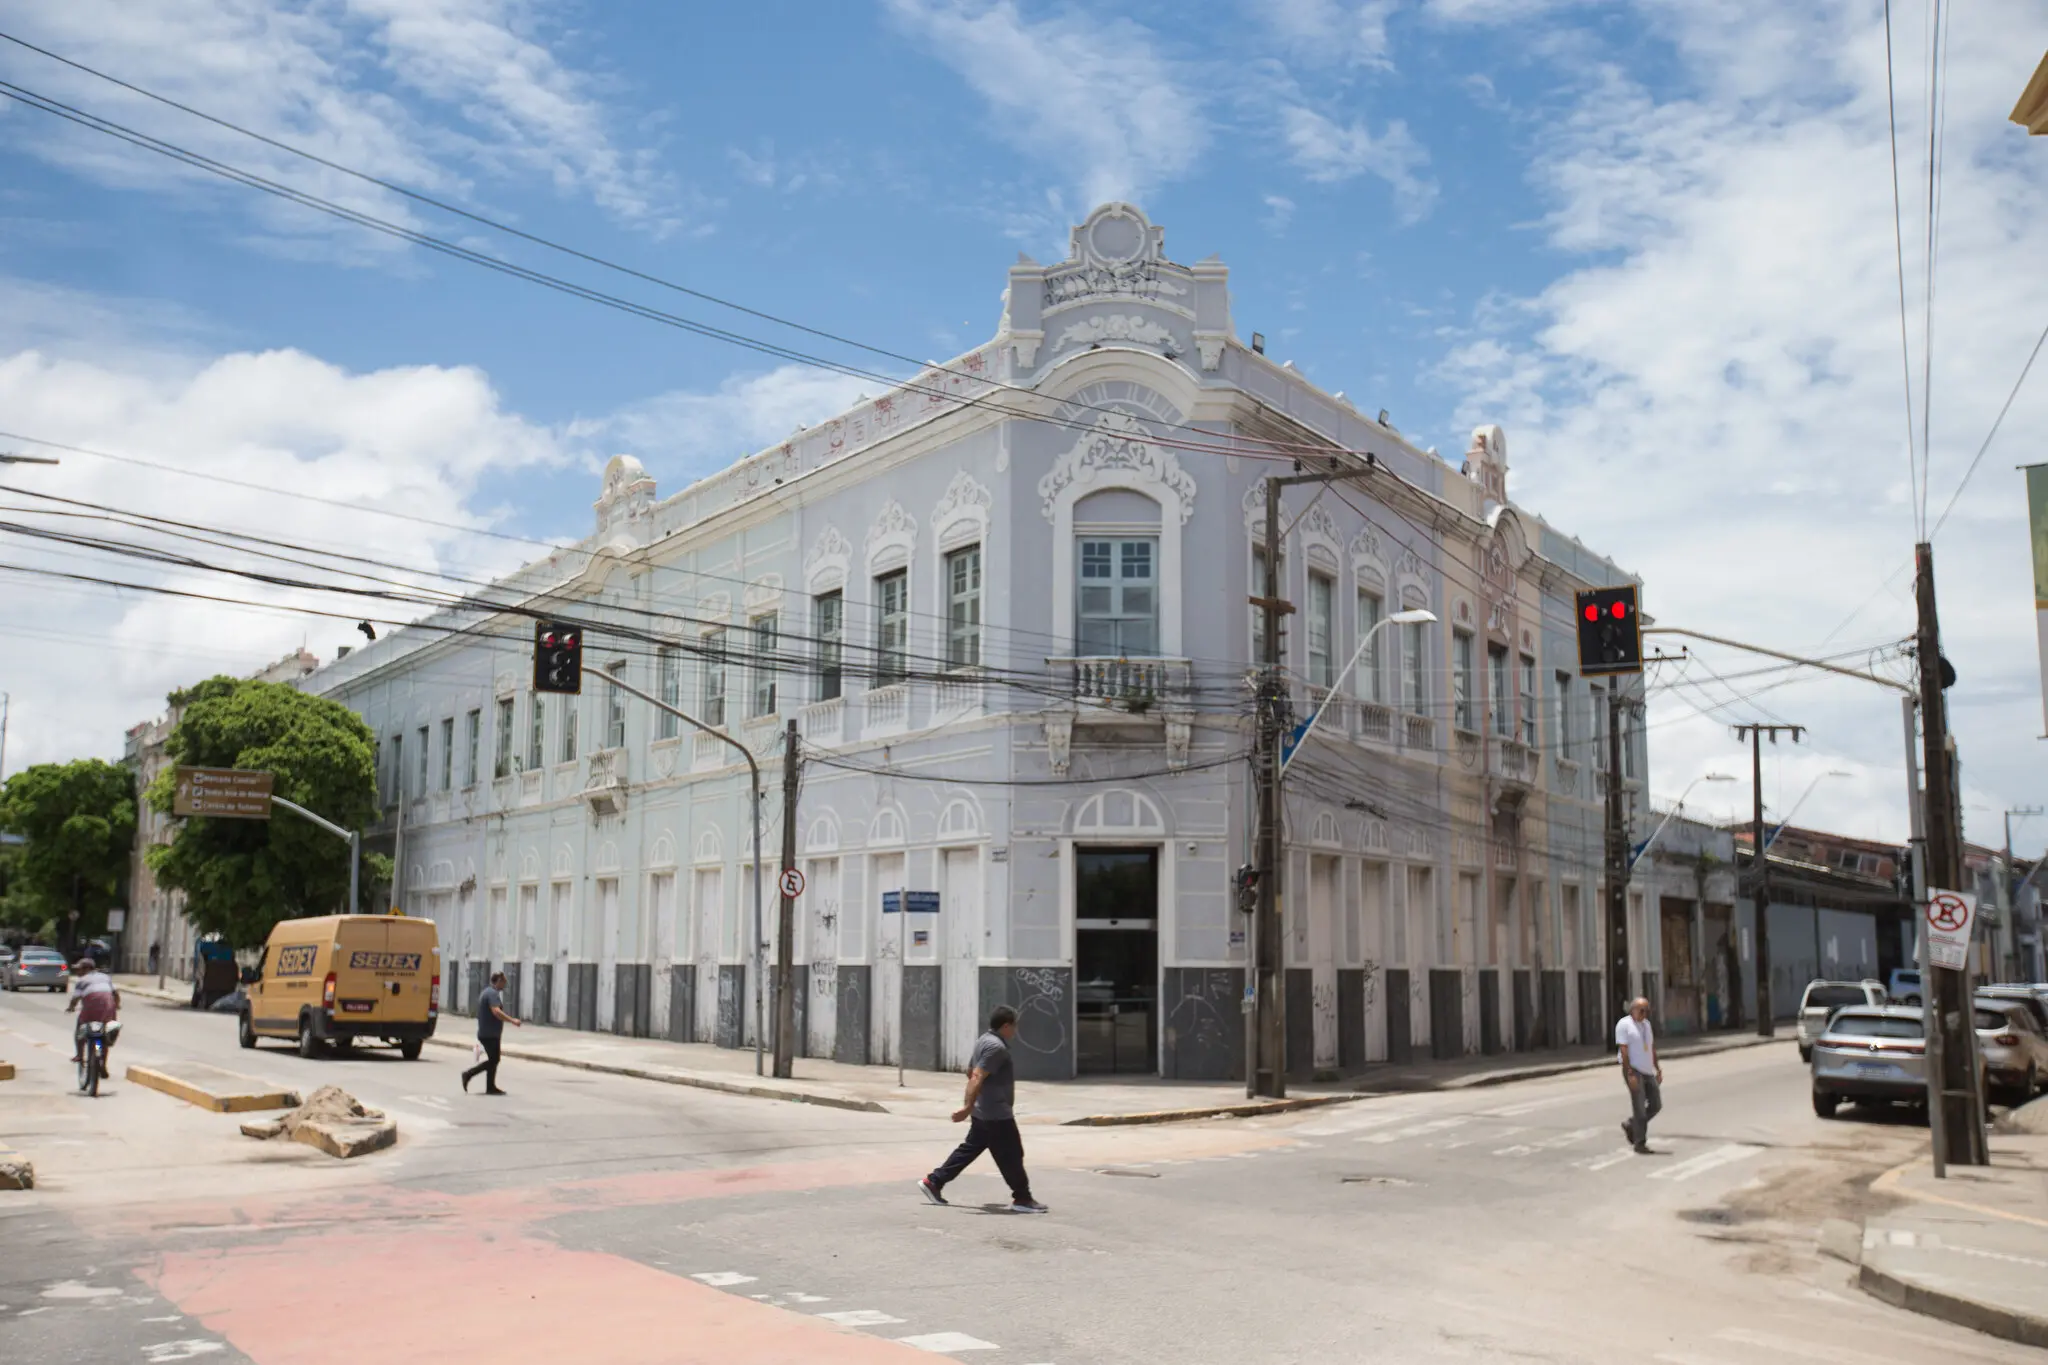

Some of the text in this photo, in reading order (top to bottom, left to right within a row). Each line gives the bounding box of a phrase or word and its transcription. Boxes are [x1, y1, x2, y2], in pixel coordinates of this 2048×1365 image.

[786, 874, 798, 891] E
[280, 947, 316, 973] SEDEX
[353, 952, 418, 969] SEDEX
